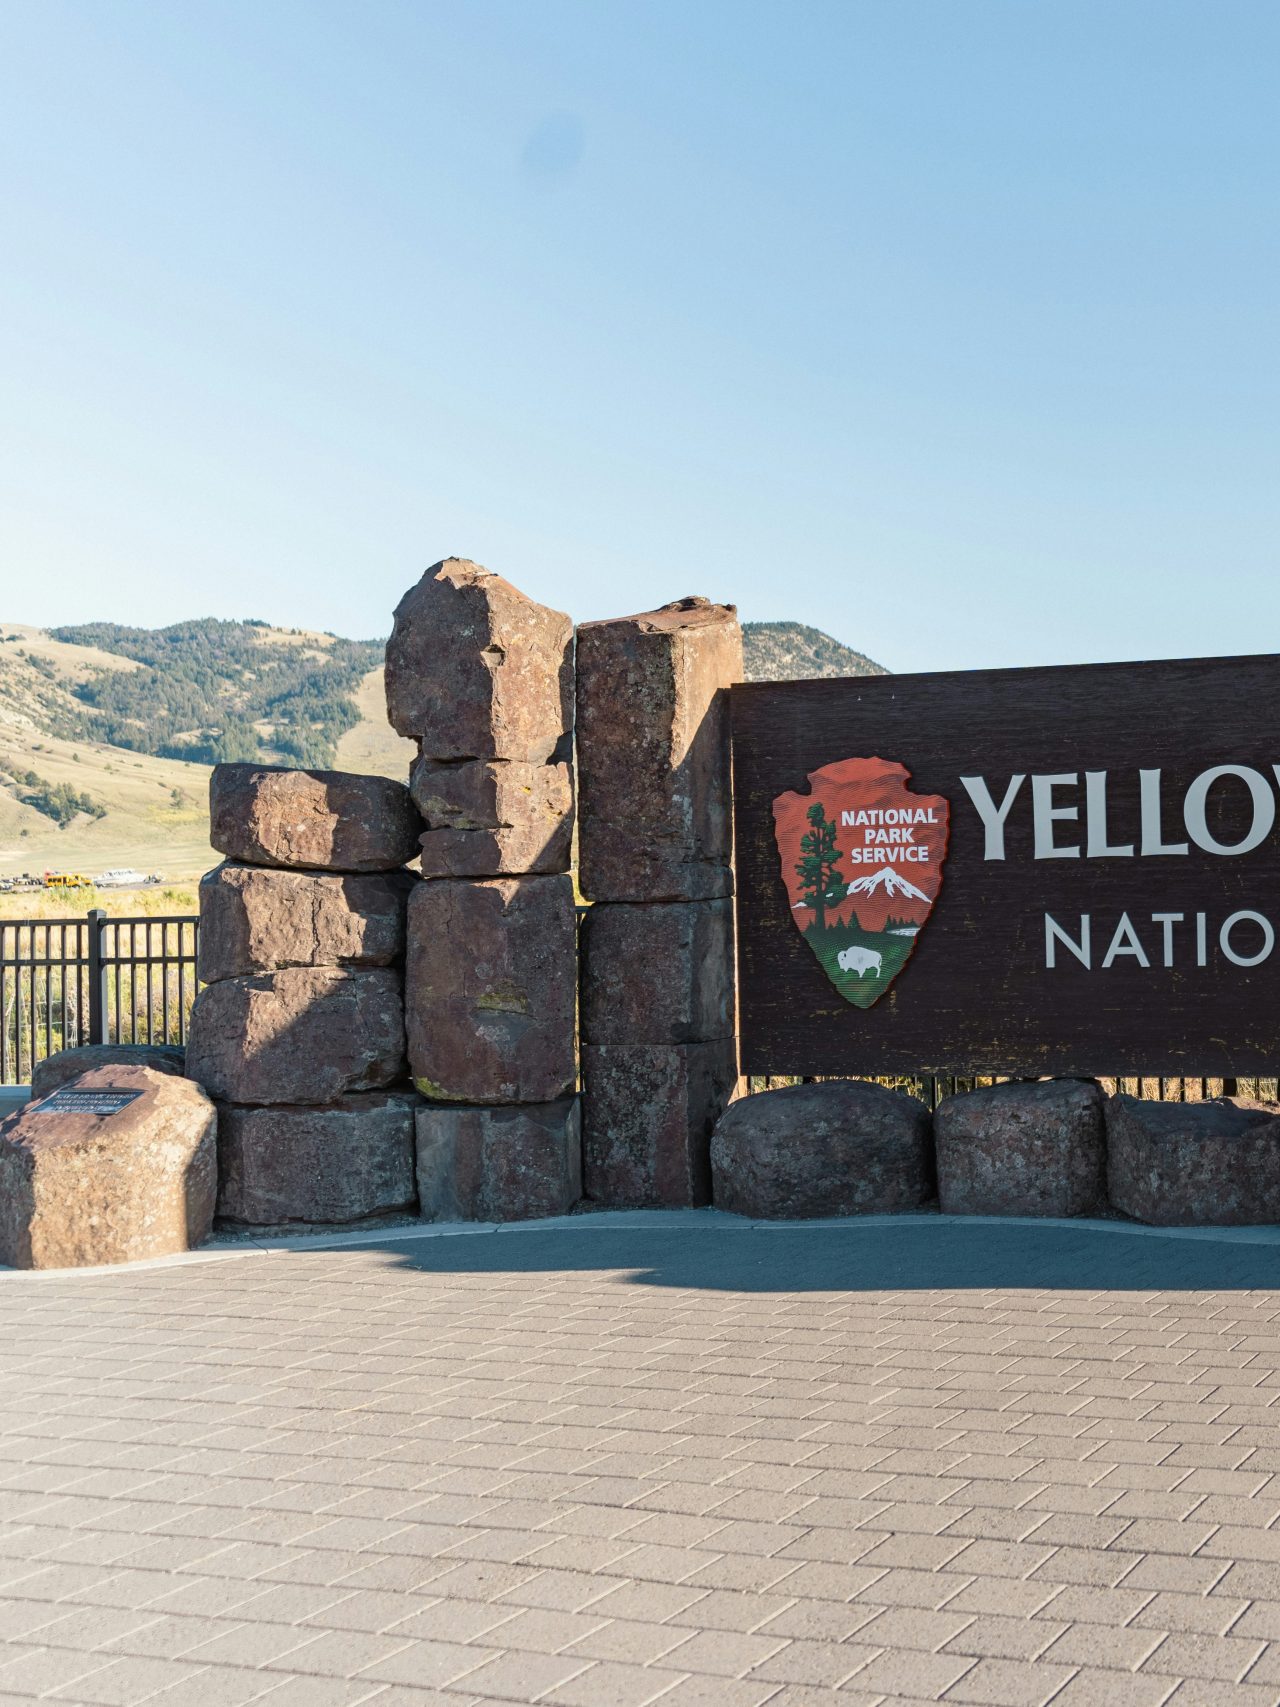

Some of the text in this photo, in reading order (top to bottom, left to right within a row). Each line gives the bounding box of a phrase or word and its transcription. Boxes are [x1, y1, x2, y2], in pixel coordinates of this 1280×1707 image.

[841, 808, 939, 827] NATIONAL
[864, 828, 915, 845] PARK
[851, 846, 929, 864] SERVICE
